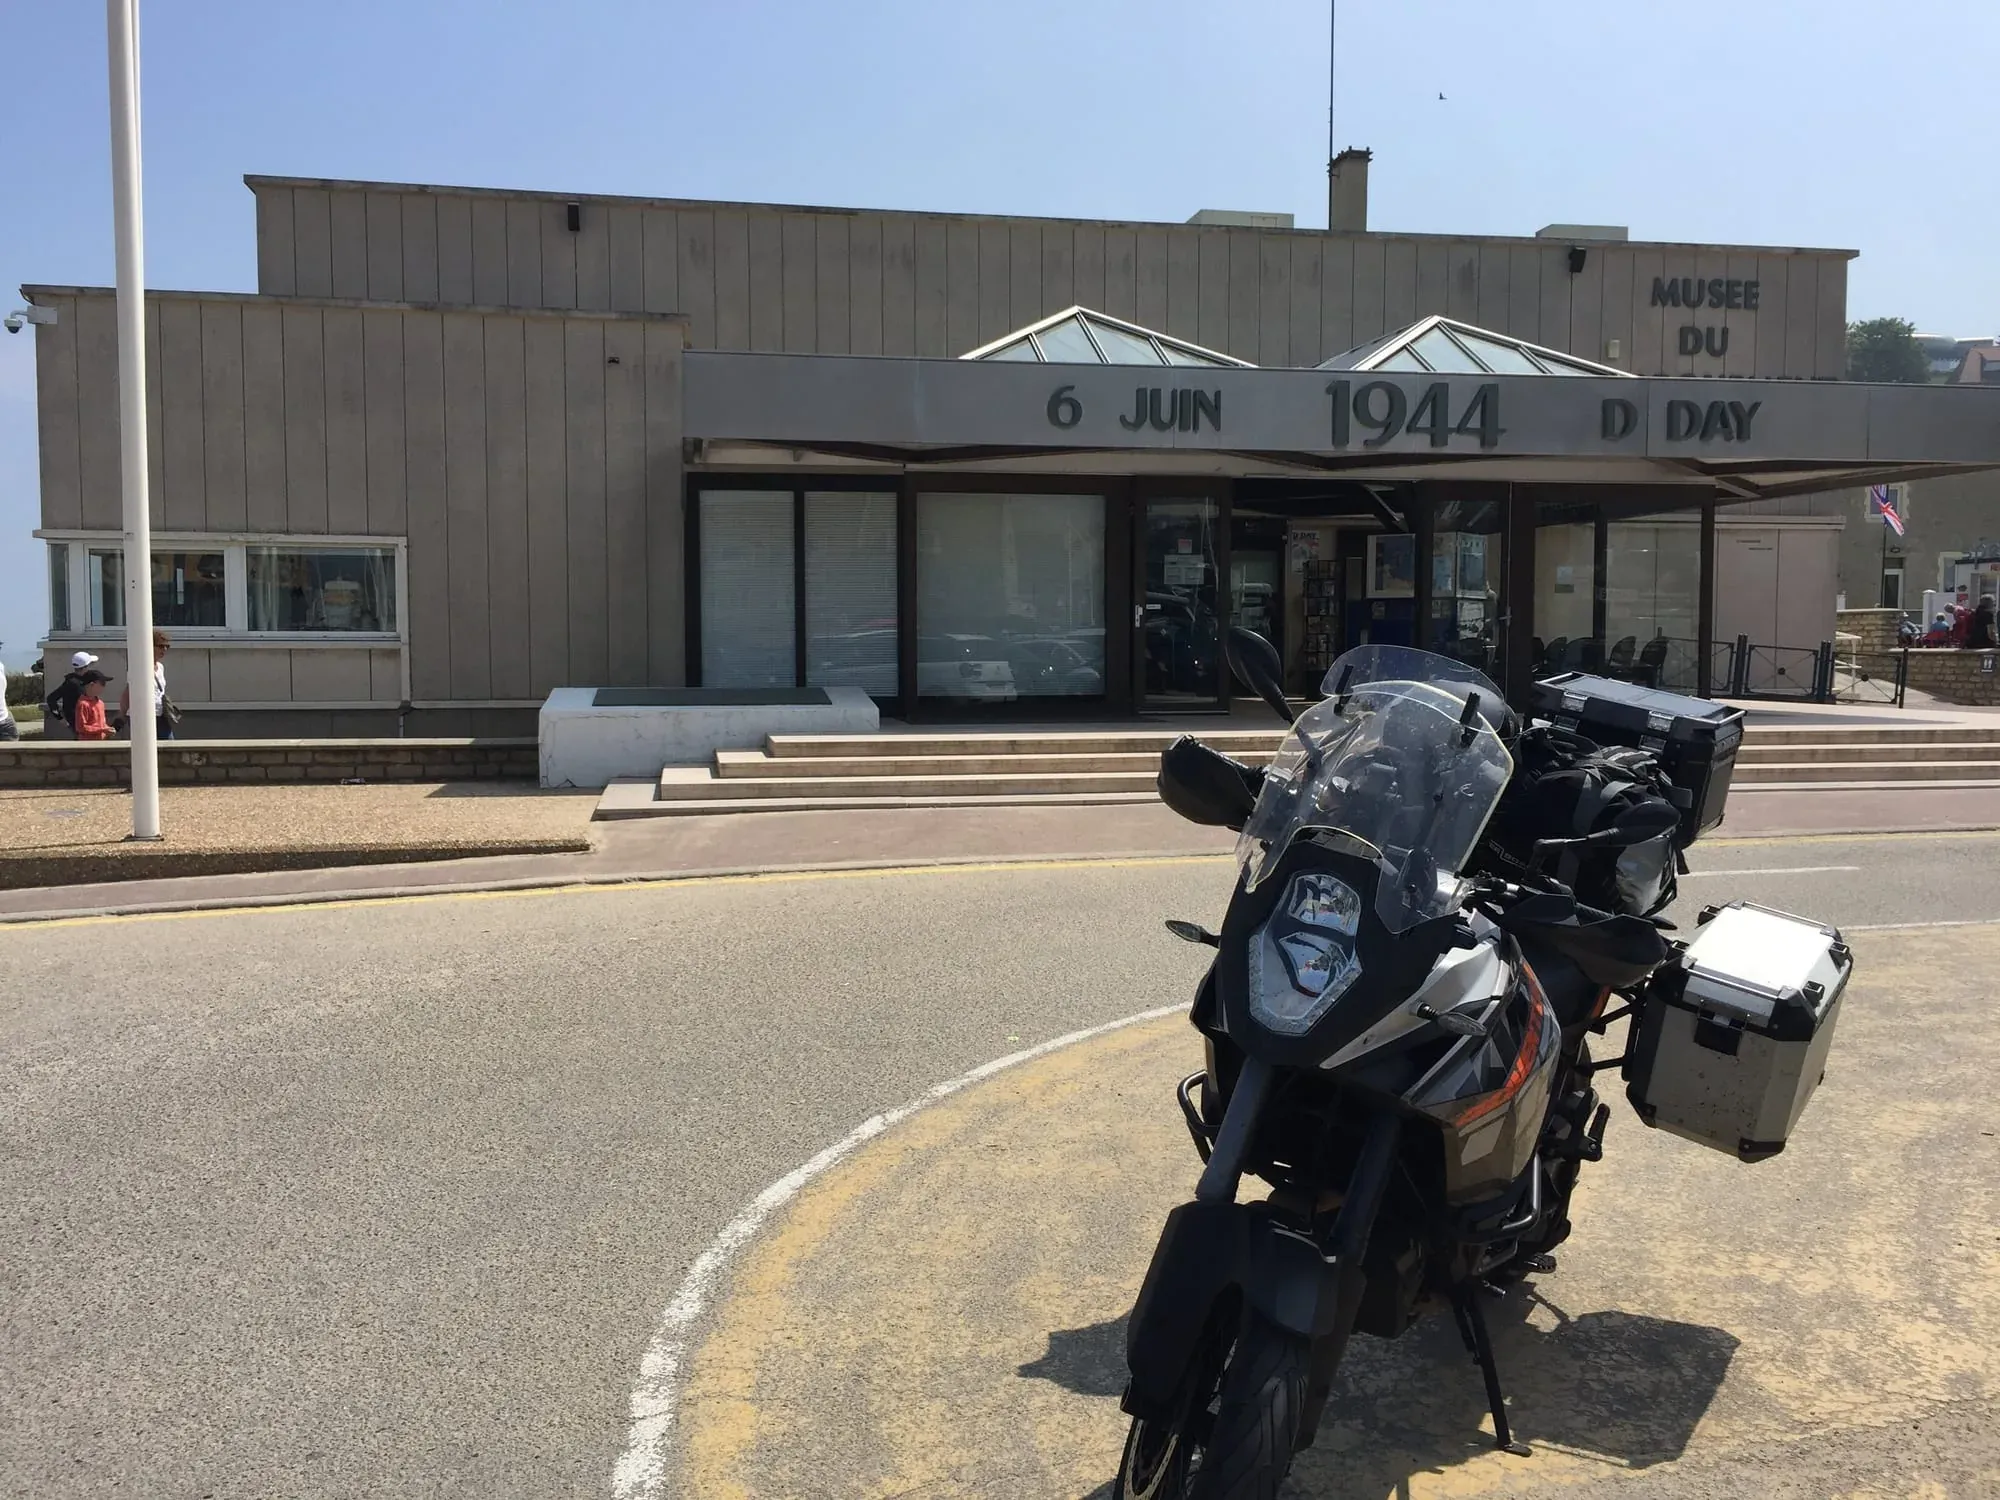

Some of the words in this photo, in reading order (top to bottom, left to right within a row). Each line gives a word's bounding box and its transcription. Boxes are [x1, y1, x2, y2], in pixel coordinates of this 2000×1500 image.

[1651, 277, 1760, 309] MUSEE
[1679, 326, 1729, 357] DU
[1047, 385, 1083, 430] 6
[1119, 387, 1222, 432] JUIN
[1325, 380, 1507, 448] 1944
[1601, 398, 1638, 441] D
[1666, 399, 1763, 442] DAY
